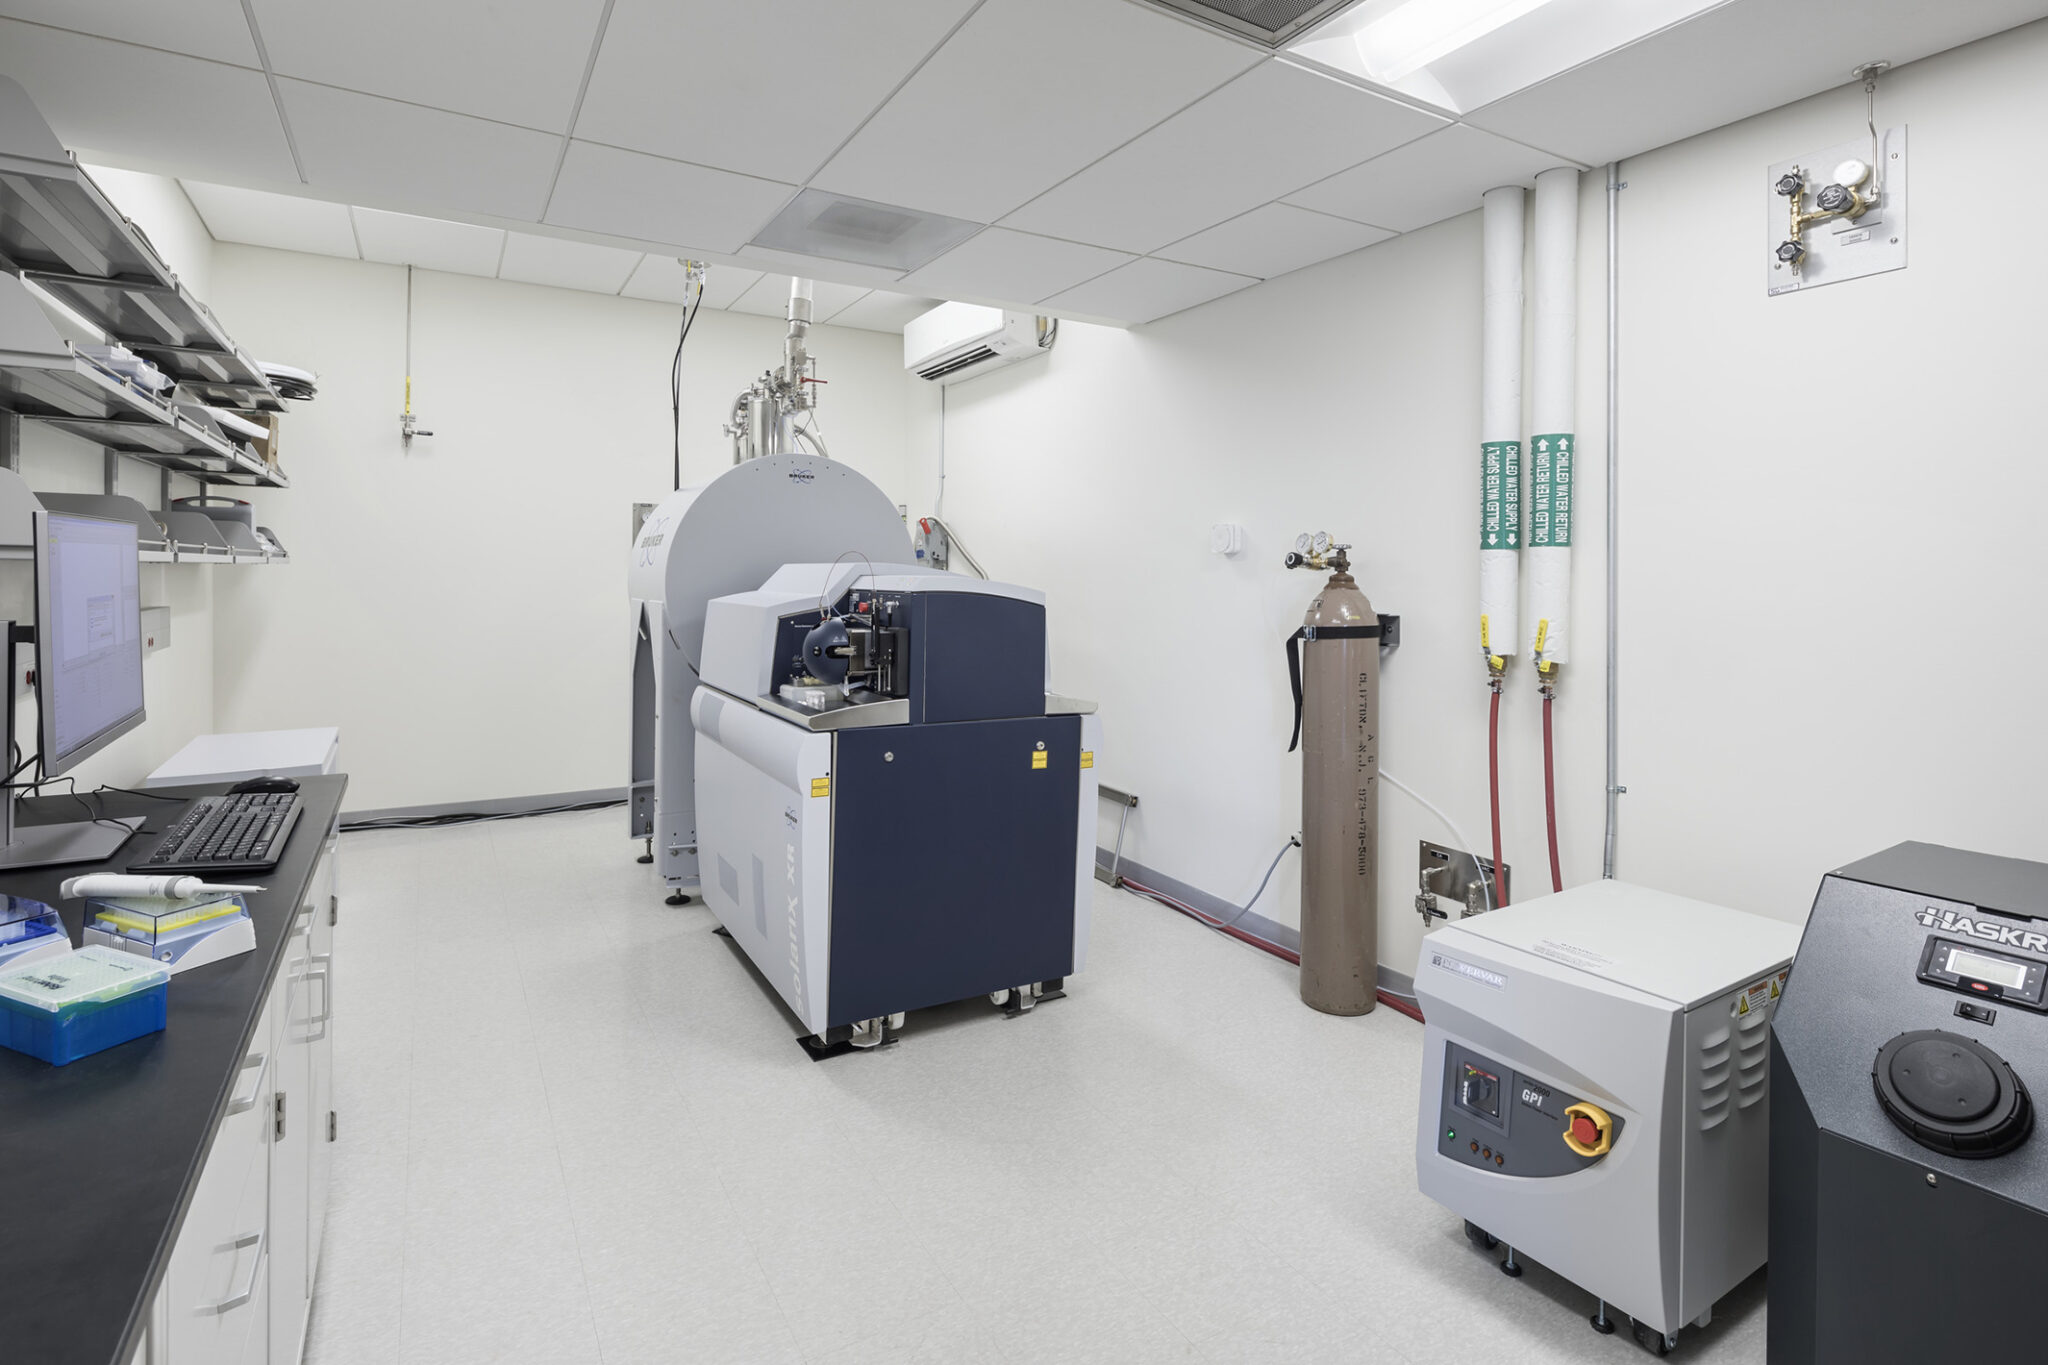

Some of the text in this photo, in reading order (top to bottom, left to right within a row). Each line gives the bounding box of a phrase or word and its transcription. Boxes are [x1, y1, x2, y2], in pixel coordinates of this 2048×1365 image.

[1487, 446, 1500, 532] CHILLED WATER SUPPLY
[1505, 445, 1518, 531] CHILLED WATER SUPPLY
[1535, 452, 1550, 543] CHILLED WATER RETURN
[1555, 451, 1569, 543] CHILLED WATER RETURN
[641, 534, 664, 549] BRUKER
[786, 843, 796, 886] XR
[1915, 906, 2048, 953] HASKR
[1521, 1088, 1543, 1107] GPI
